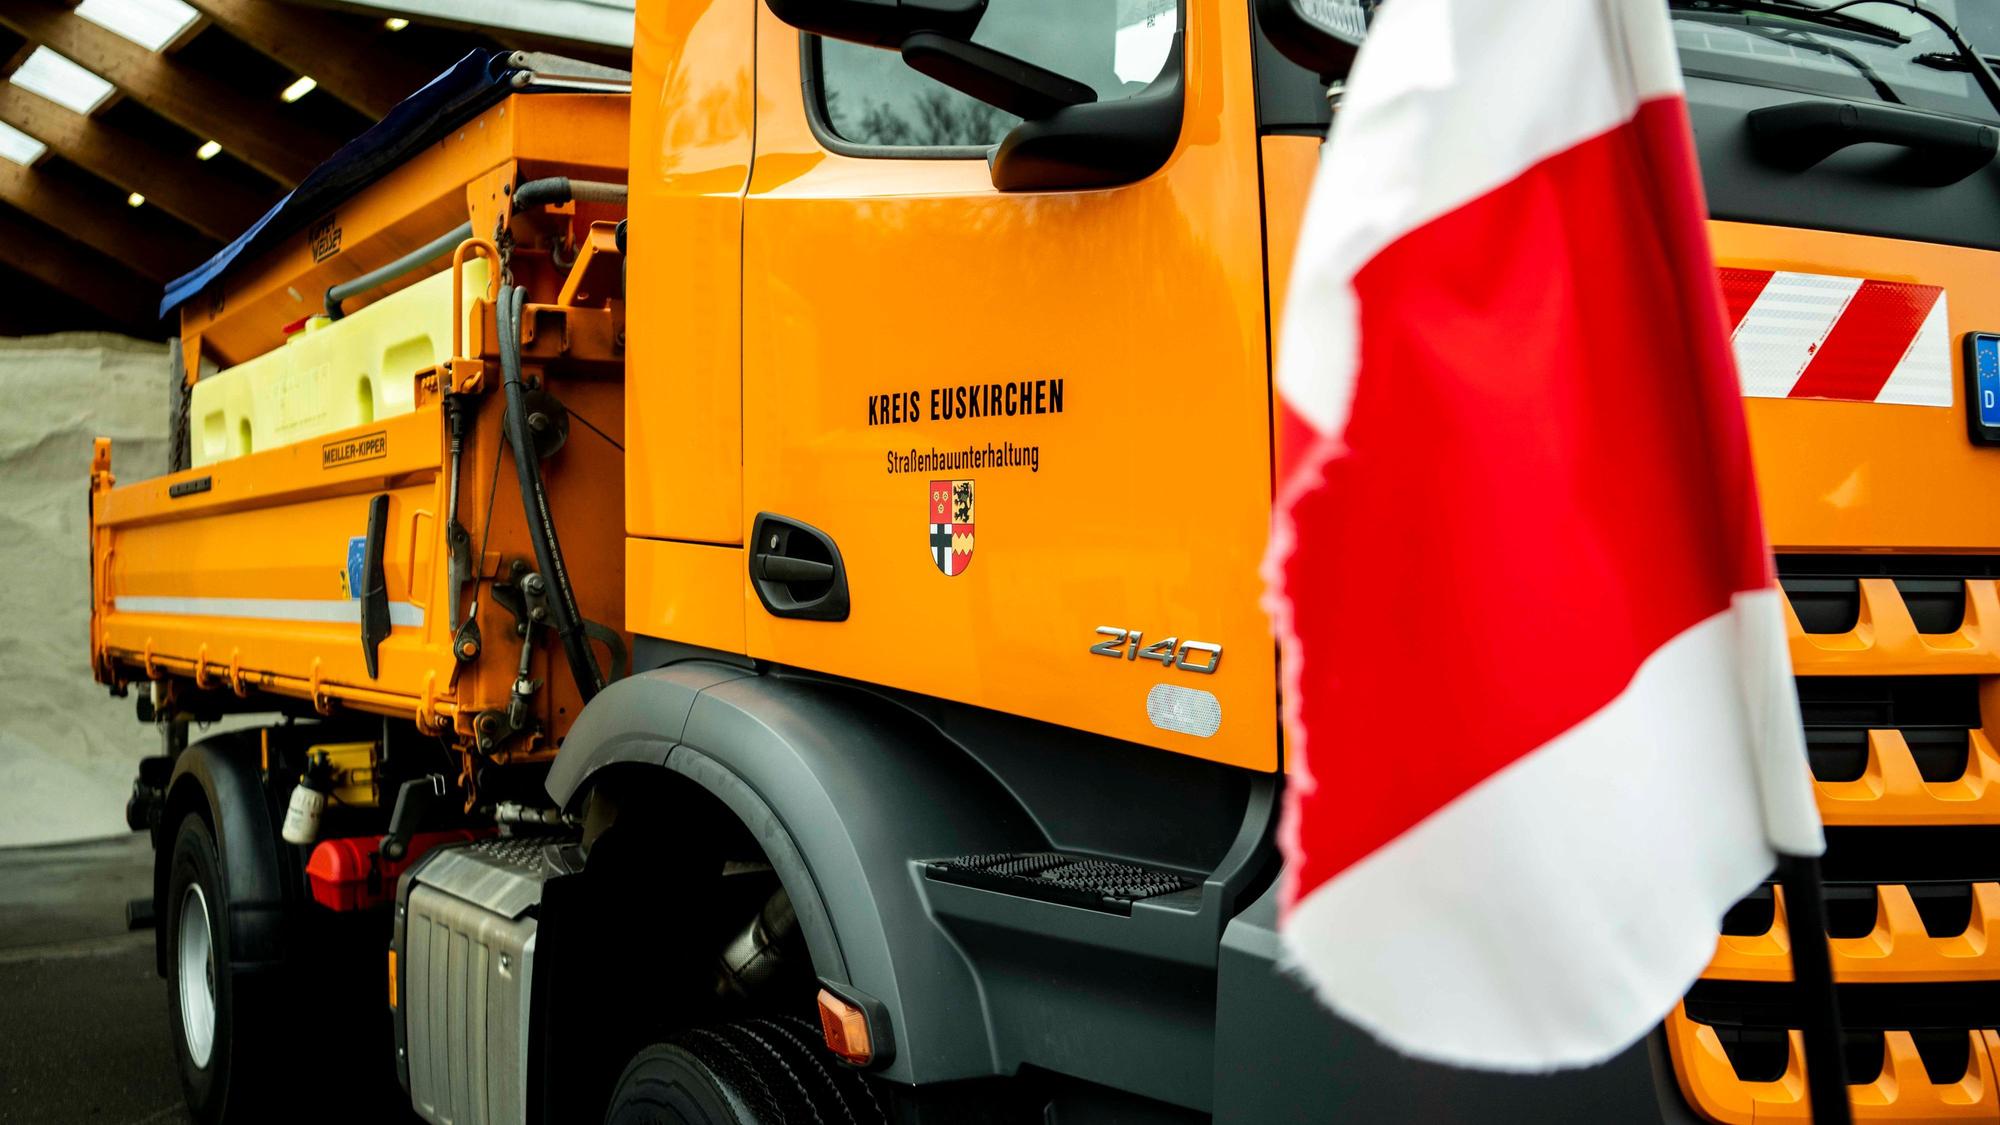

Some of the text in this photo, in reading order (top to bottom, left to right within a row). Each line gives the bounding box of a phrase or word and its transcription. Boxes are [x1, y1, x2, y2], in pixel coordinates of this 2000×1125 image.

[868, 378, 1064, 426] KREIS EUSKIRCHEN
[1984, 389, 1995, 409] D
[324, 438, 385, 464] MEILLER-KIPPER
[887, 441, 1039, 474] Straßenbauunterhaltung
[1089, 625, 1223, 675] 2140
